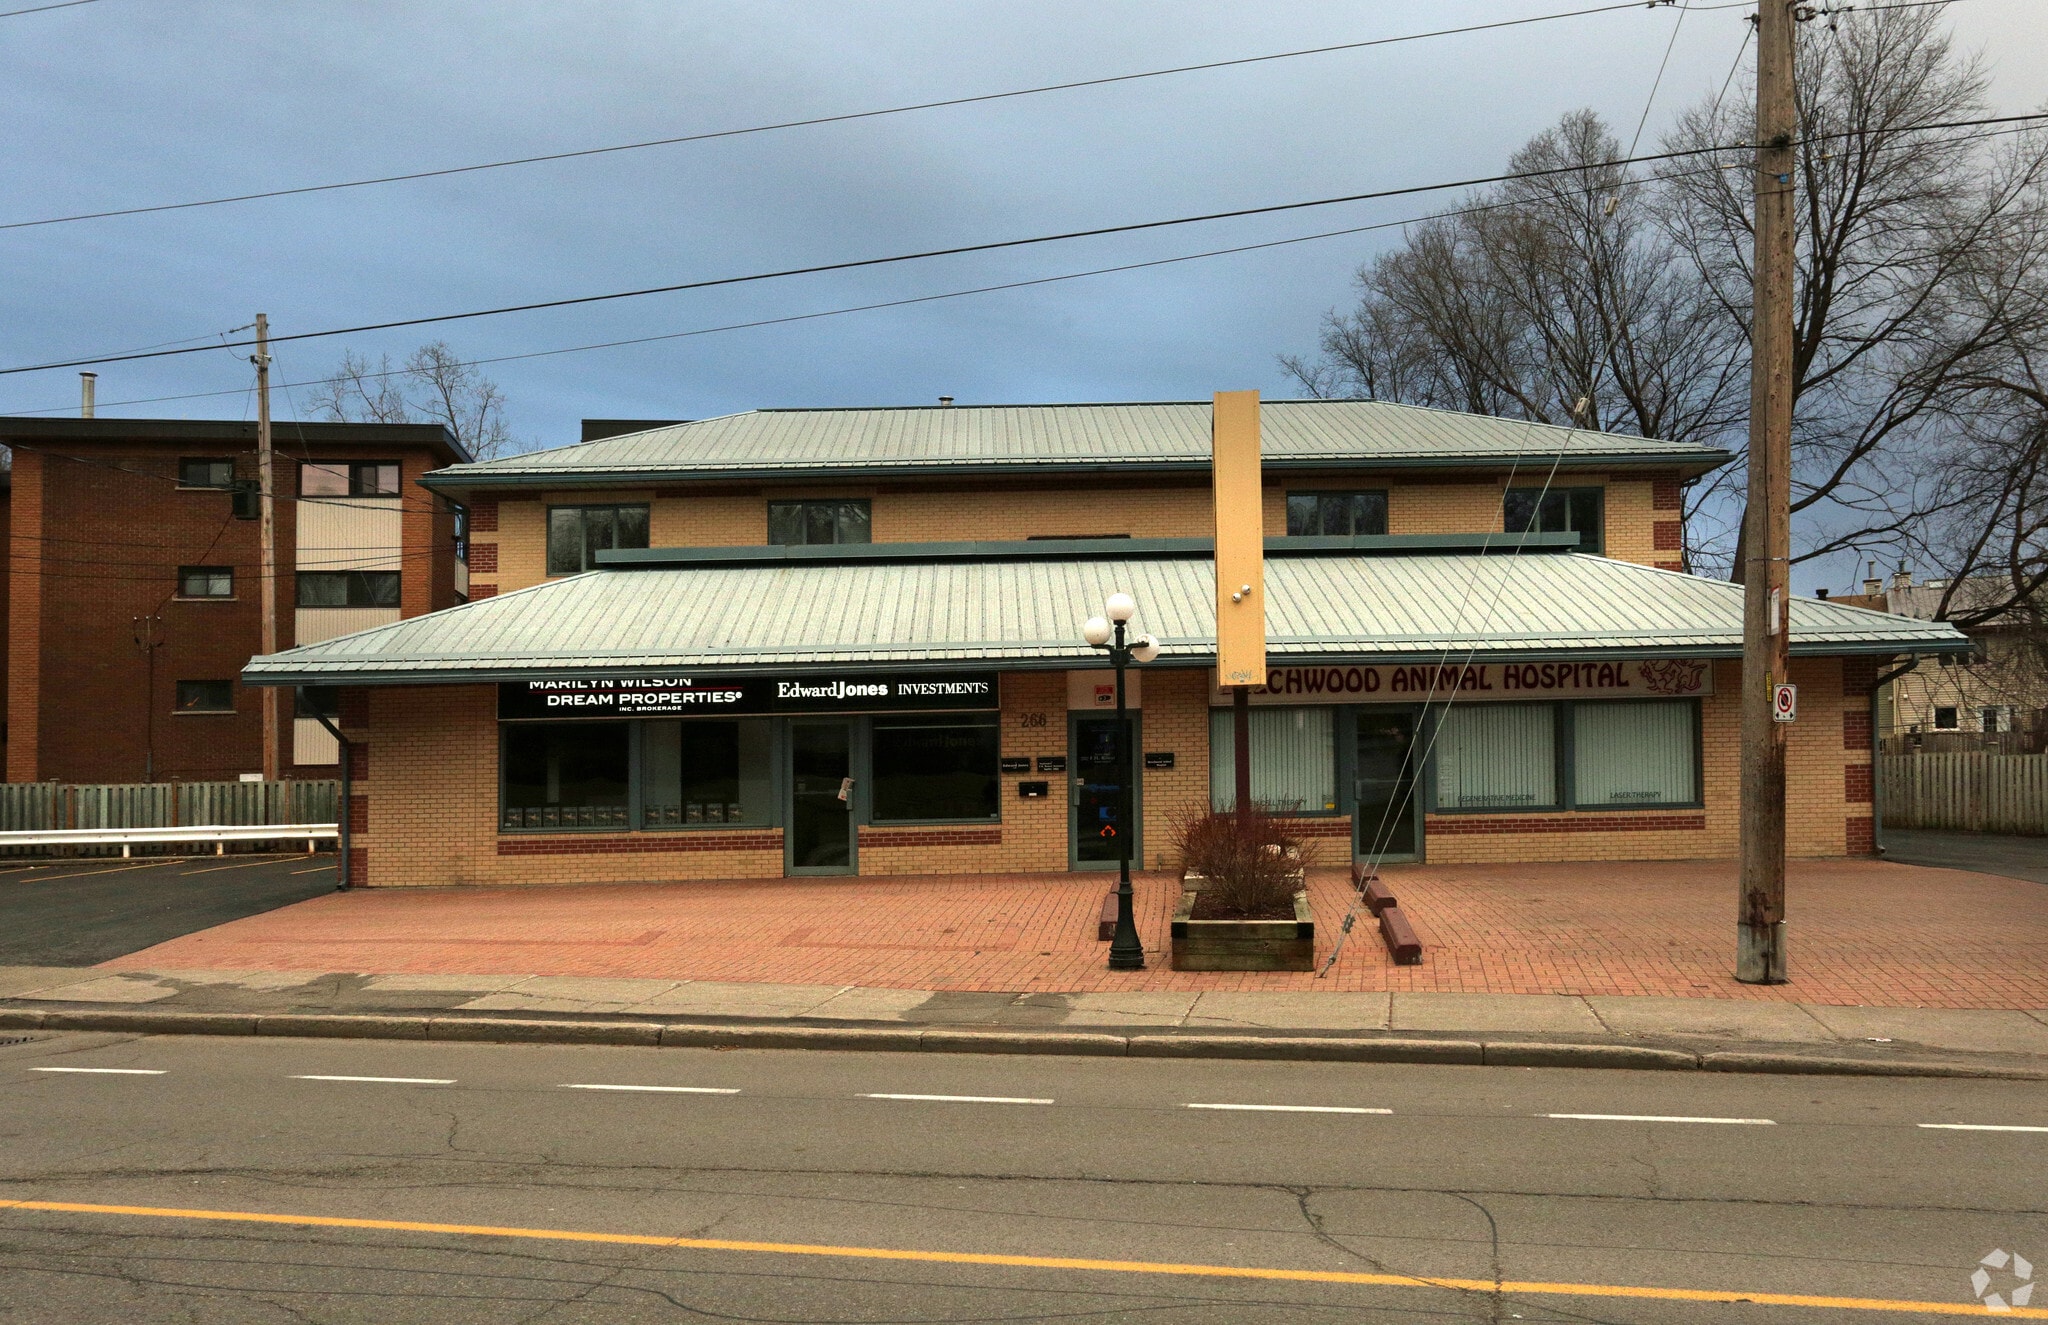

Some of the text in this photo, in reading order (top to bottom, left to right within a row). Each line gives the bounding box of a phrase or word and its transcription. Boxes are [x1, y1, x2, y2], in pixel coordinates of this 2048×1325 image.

[529, 678, 692, 690] MARILYN WILSON
[1220, 667, 1381, 695] CHWOOD
[1391, 665, 1492, 692] ANIMAL
[1503, 662, 1630, 690] HOSPITAL
[897, 681, 989, 696] INVESTMENTS
[547, 693, 613, 706] DREAM
[1021, 712, 1047, 728] 266
[1632, 791, 1661, 799] THERAPY
